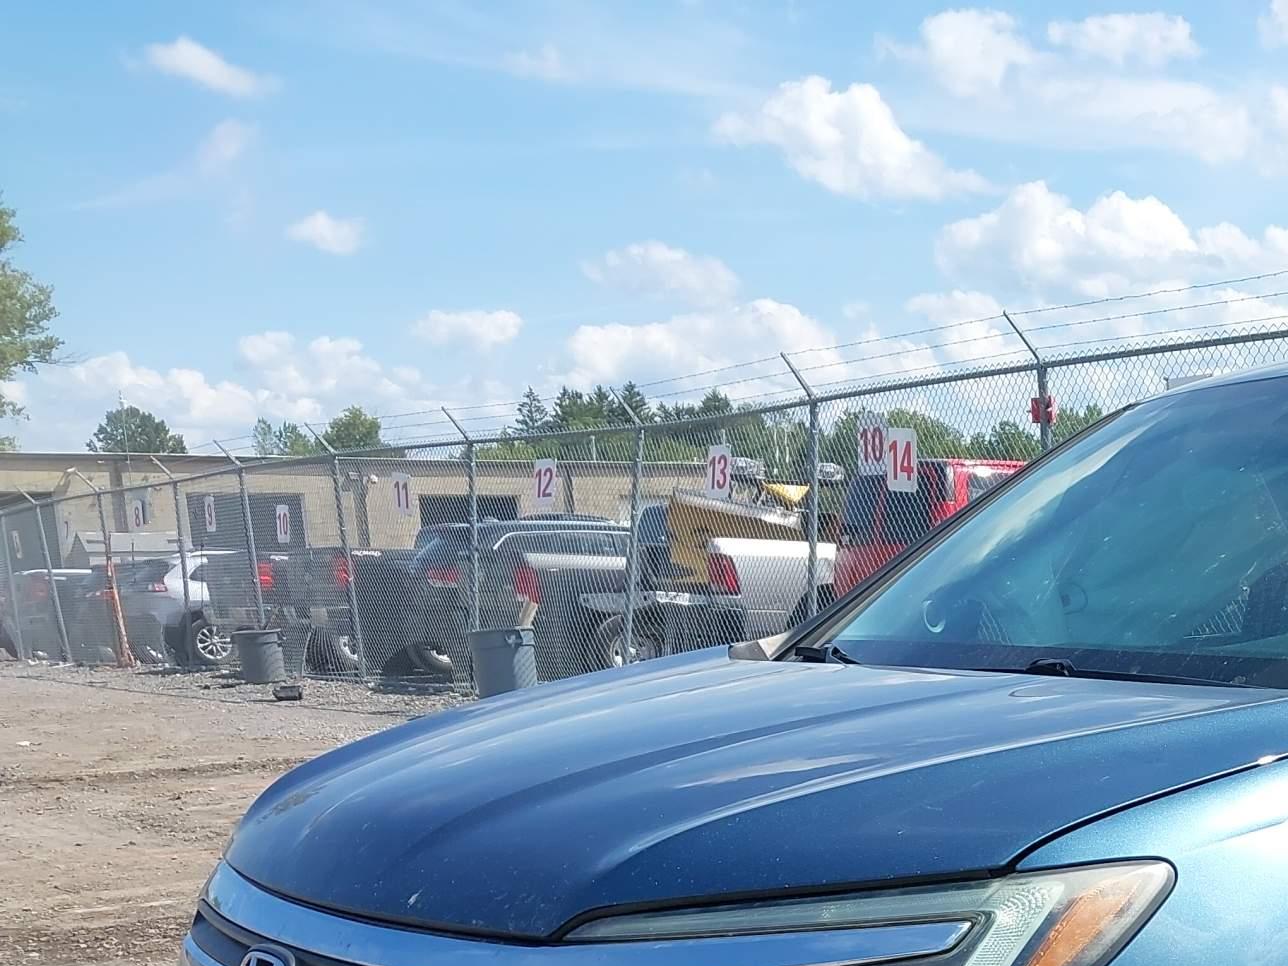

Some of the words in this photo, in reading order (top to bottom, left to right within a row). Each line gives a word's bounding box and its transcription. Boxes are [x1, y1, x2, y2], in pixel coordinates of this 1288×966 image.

[708, 454, 728, 490] 13
[888, 439, 914, 482] 14
[393, 480, 410, 510] 11
[535, 467, 554, 498] 12
[133, 506, 142, 528] 8
[206, 504, 214, 526] 9
[277, 512, 289, 536] 10
